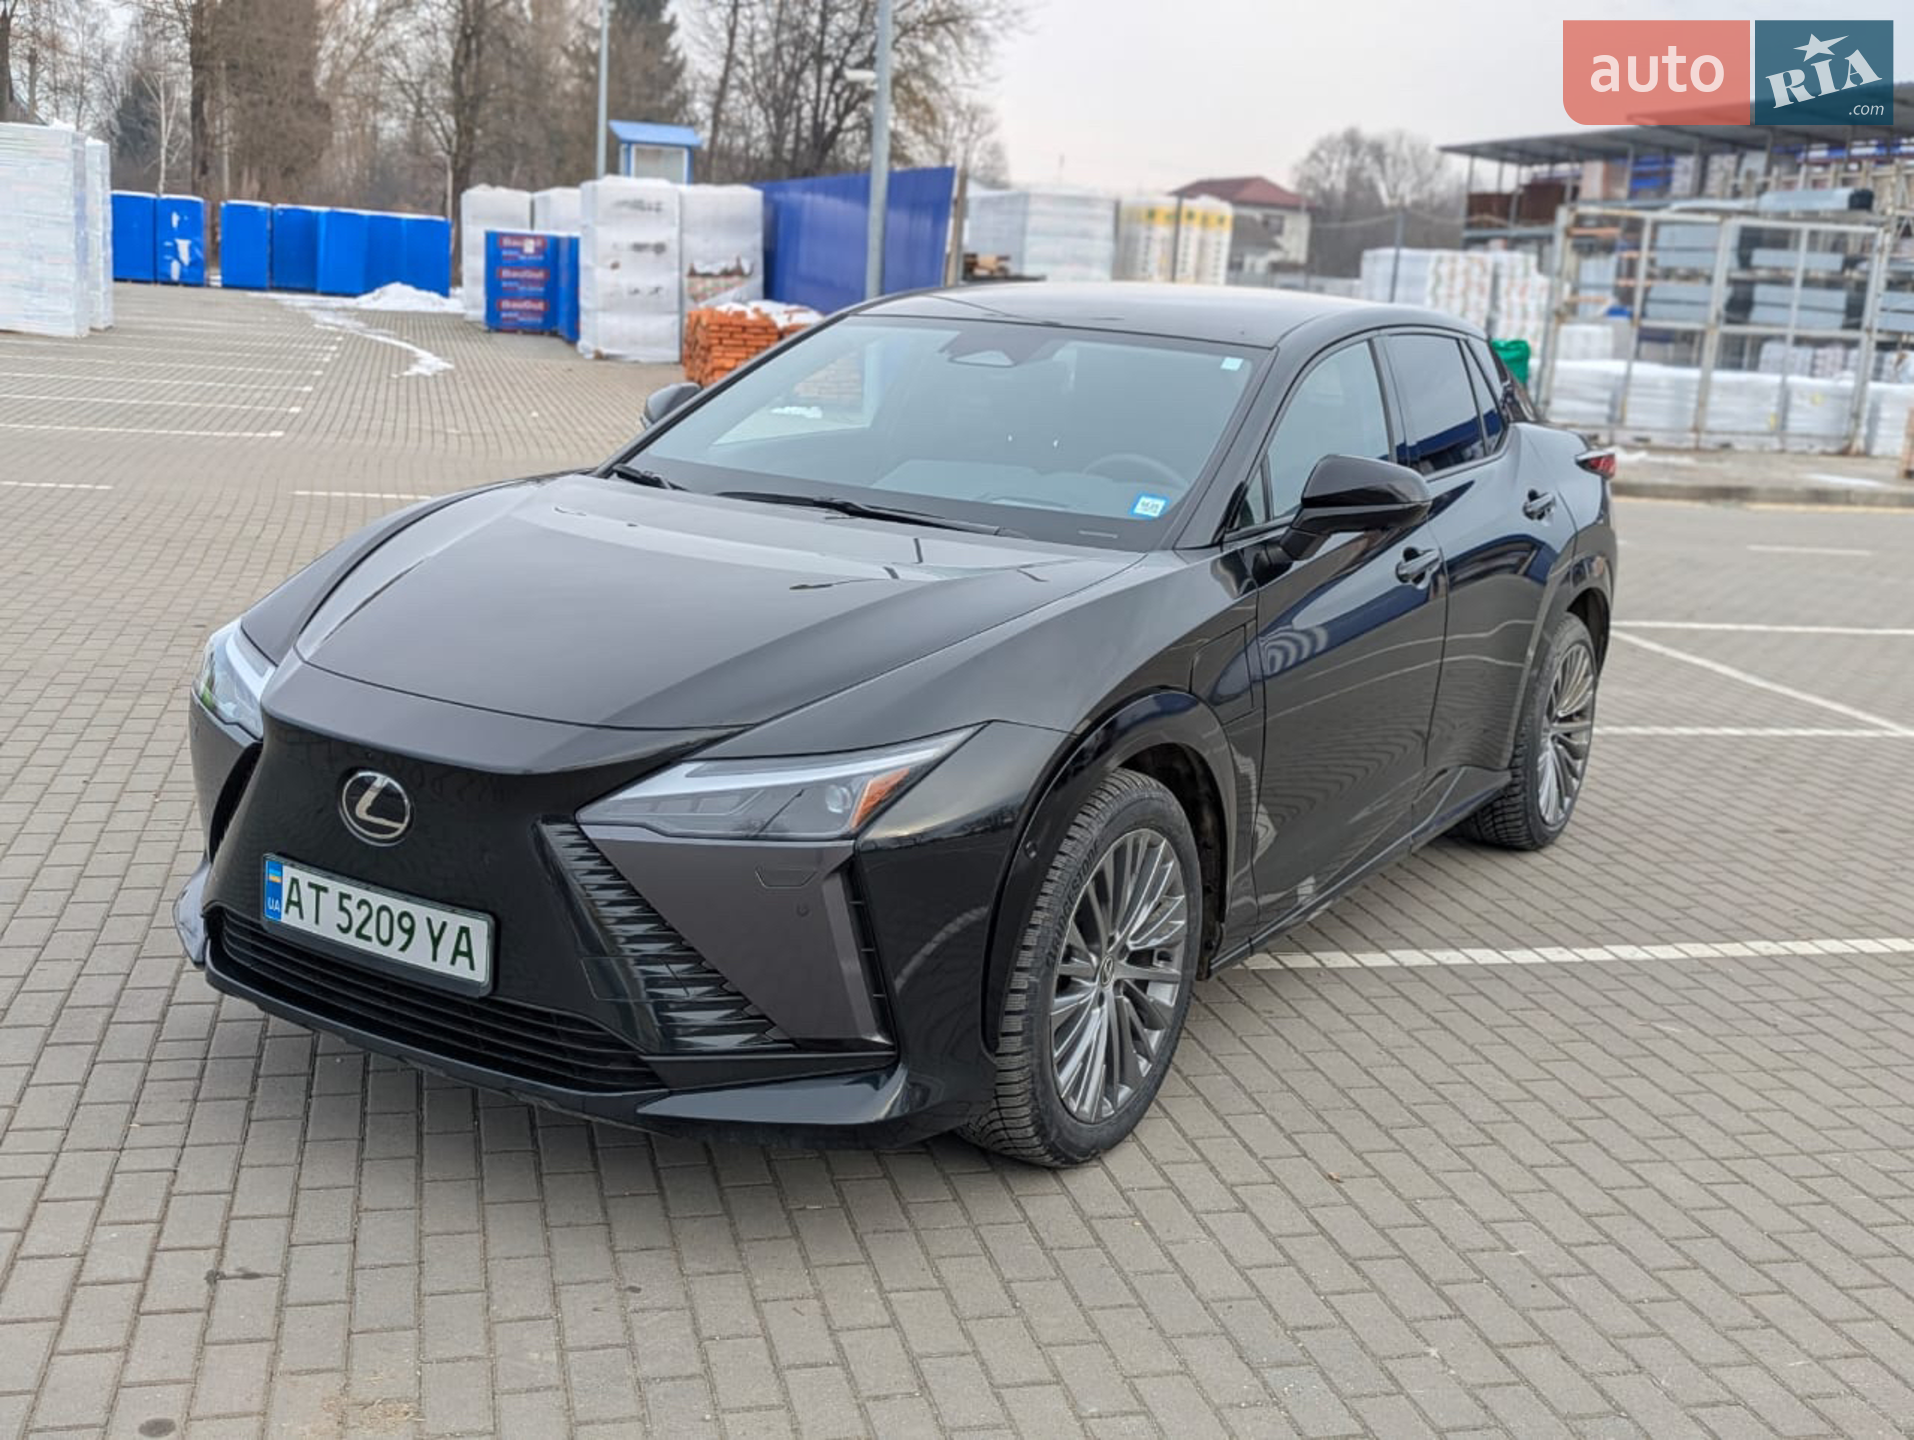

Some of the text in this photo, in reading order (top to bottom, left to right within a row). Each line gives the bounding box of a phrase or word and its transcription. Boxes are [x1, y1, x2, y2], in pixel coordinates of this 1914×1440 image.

[267, 897, 281, 912] UA
[284, 877, 476, 972] AT 5209 YA
